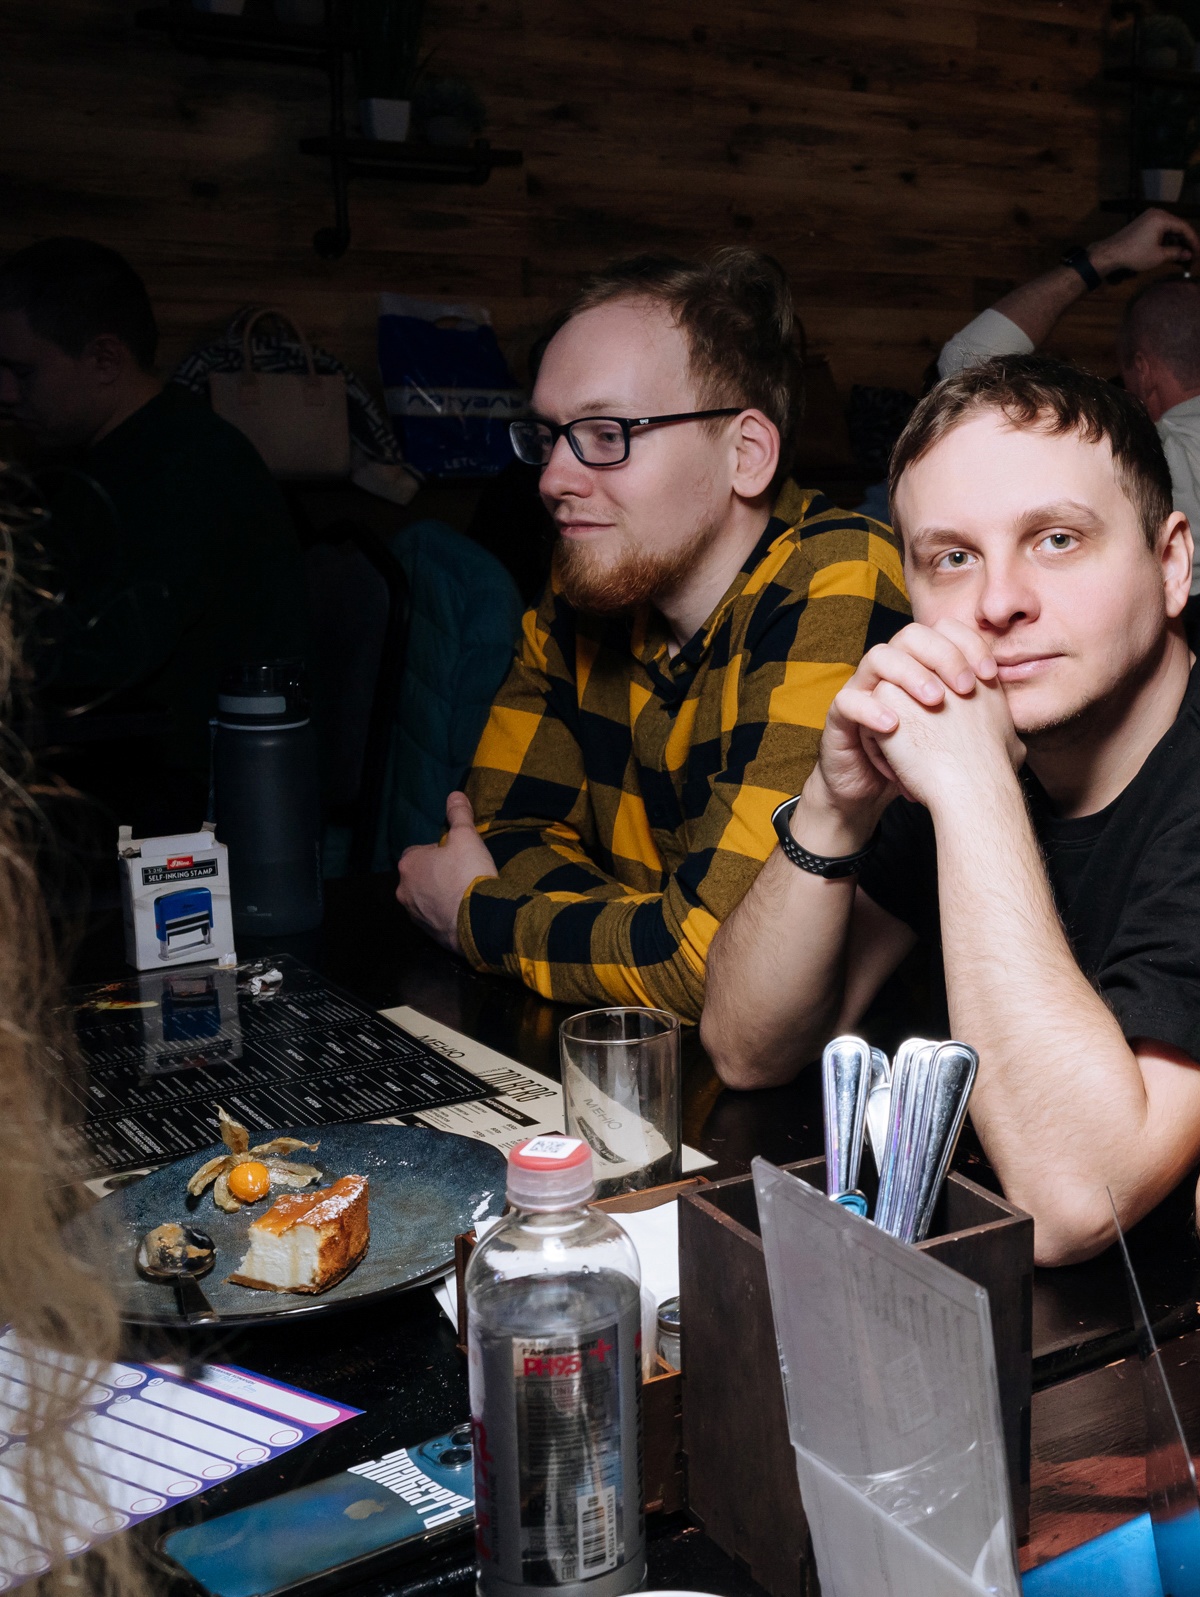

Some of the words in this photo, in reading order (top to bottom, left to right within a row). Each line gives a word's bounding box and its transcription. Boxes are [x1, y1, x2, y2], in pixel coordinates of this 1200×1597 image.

[148, 871, 190, 882] SELF-INKING
[190, 868, 213, 877] STAMP
[416, 1034, 466, 1059] МЕНЮ
[522, 1339, 598, 1356] FAHRENHEIT
